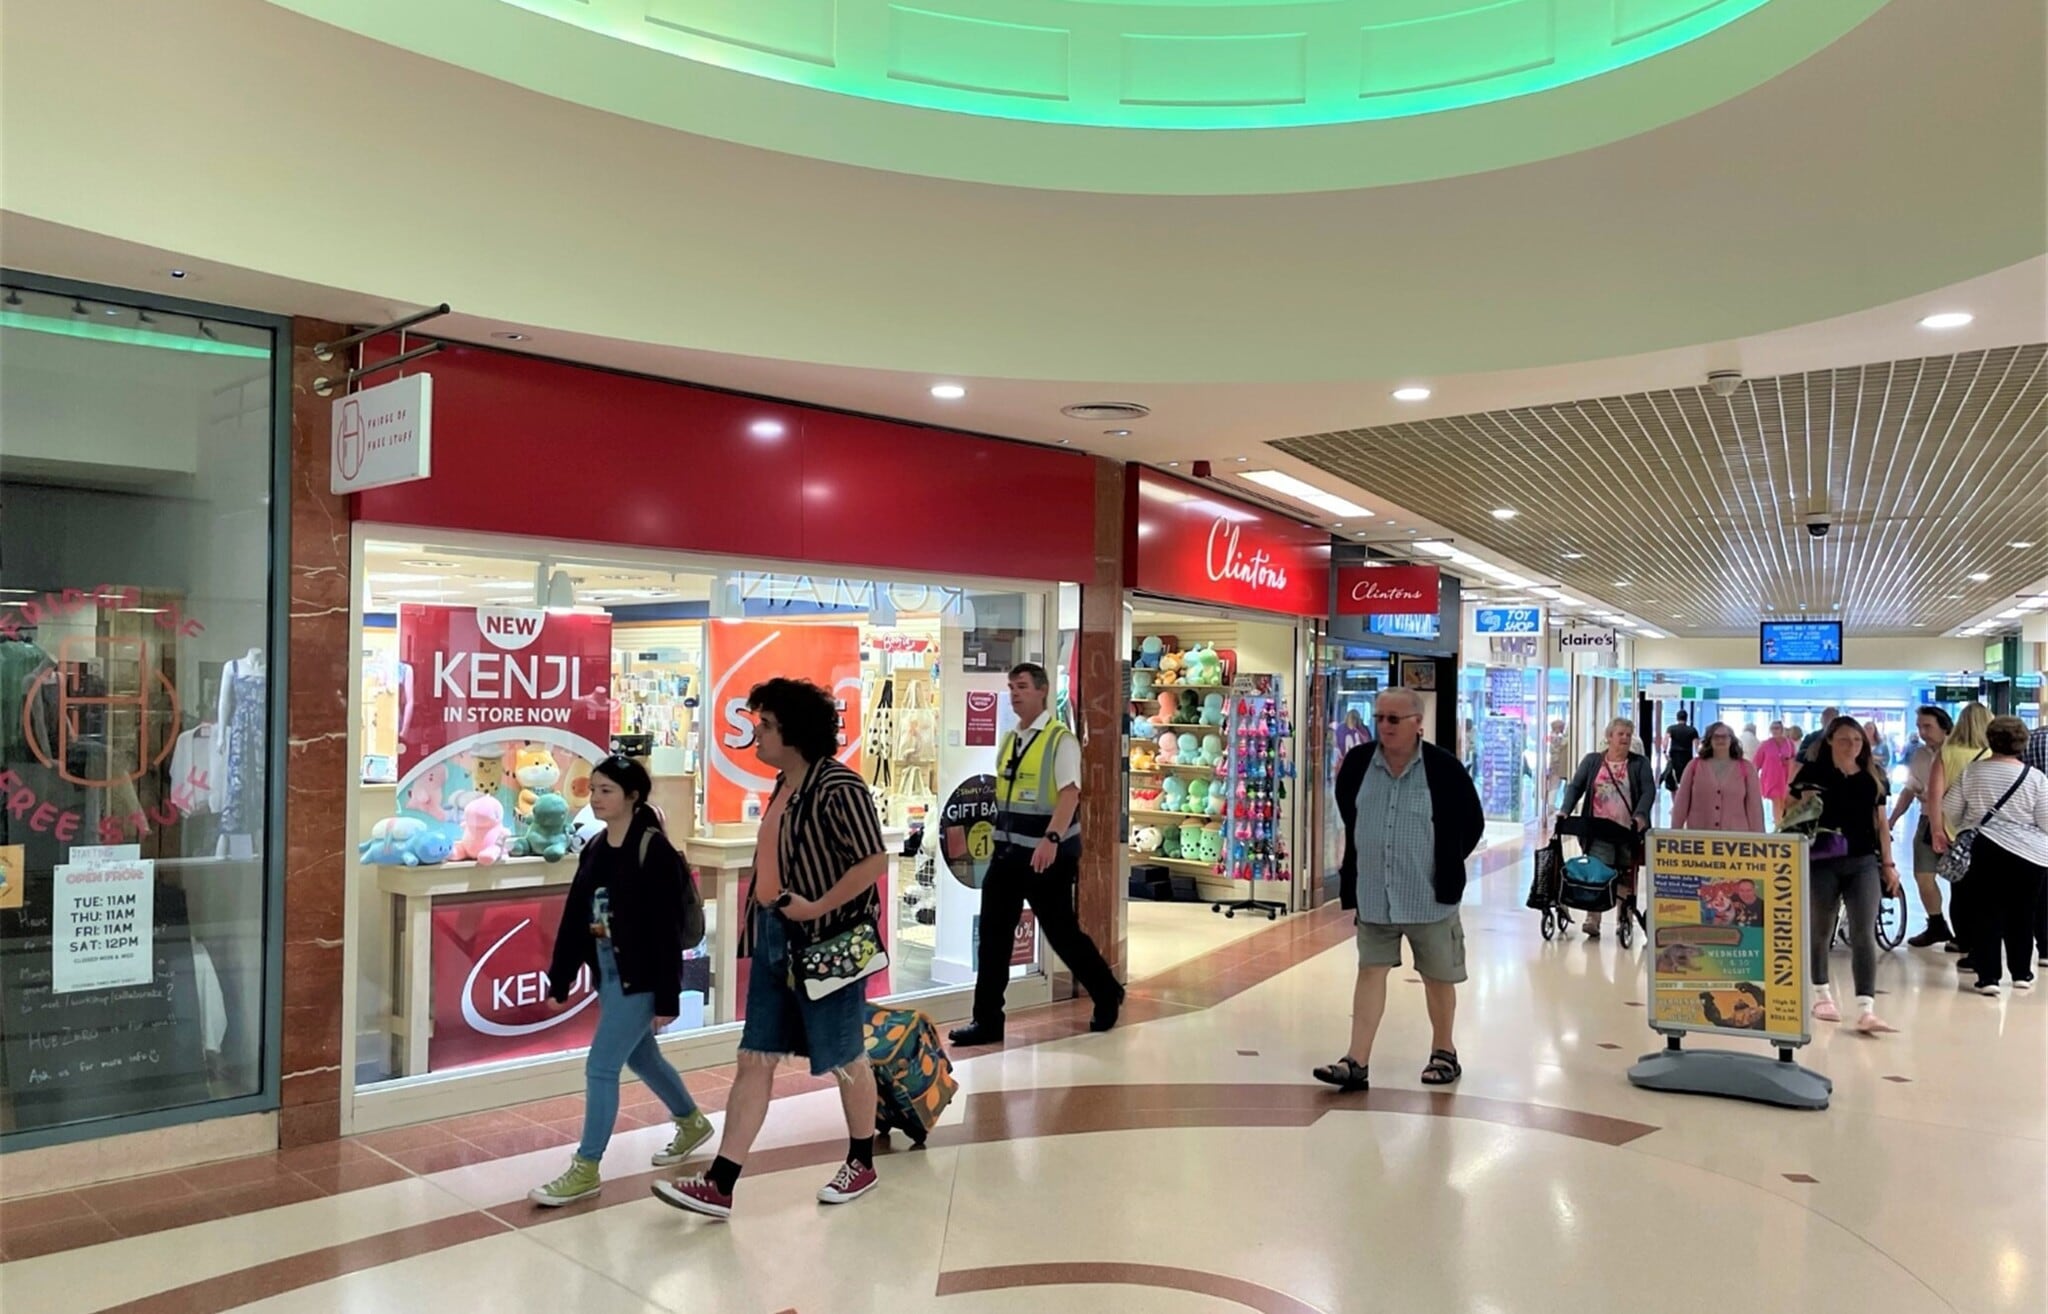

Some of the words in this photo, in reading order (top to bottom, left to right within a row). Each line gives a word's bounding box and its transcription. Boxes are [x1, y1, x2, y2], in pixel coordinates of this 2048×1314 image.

[1206, 516, 1287, 590] Clintons
[1351, 581, 1422, 601] Clintons
[1507, 610, 1532, 620] TOY
[486, 616, 536, 635] NEW
[1504, 621, 1535, 632] SHOP
[1561, 633, 1613, 646] claire's
[433, 651, 580, 700] KENJI
[444, 707, 462, 722] IN
[467, 707, 523, 723] STORE
[528, 708, 571, 723] NOW
[947, 803, 978, 820] GIFT
[981, 801, 998, 817] BA
[975, 834, 988, 857] £1
[1656, 839, 1705, 855] FREE
[1712, 841, 1792, 859] EVENTS
[1656, 859, 1679, 867] THIS
[1682, 859, 1726, 870] SUMMER
[1729, 862, 1744, 871] AT
[1746, 863, 1766, 871] THE
[74, 896, 103, 909] TUE:
[107, 894, 136, 906] 11AM
[70, 912, 102, 923] THU:
[106, 908, 134, 920] 11AM
[75, 926, 100, 937] FRI:
[104, 923, 132, 935] 11AM
[1773, 863, 1793, 986] SOVEREIGN
[70, 940, 102, 952] SAT:
[105, 936, 138, 949] 12PM
